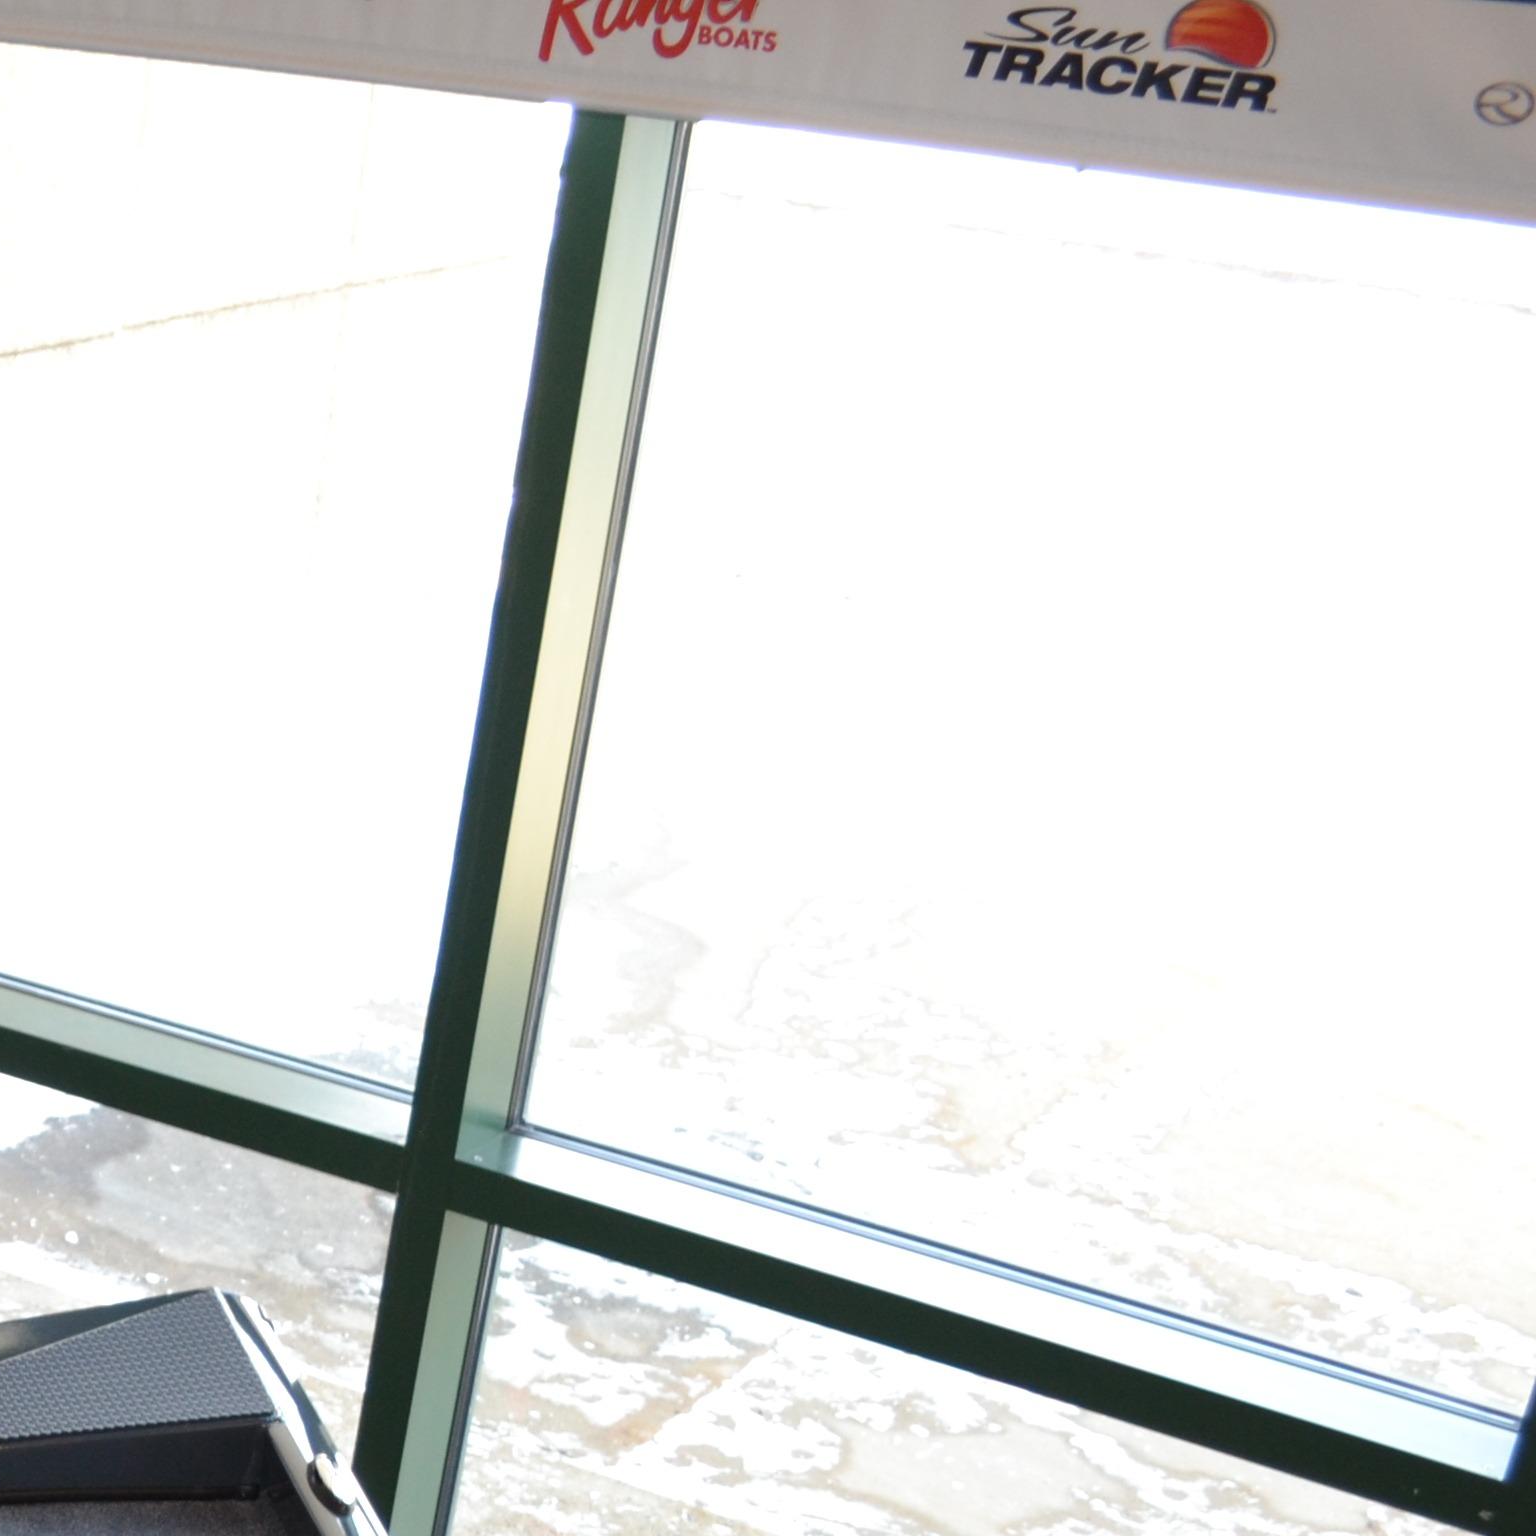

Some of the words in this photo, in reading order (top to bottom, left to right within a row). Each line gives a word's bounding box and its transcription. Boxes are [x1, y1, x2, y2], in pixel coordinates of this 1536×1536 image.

[697, 26, 777, 52] BOATS
[984, 6, 1150, 54] Sun
[963, 41, 1276, 113] TRACKER
